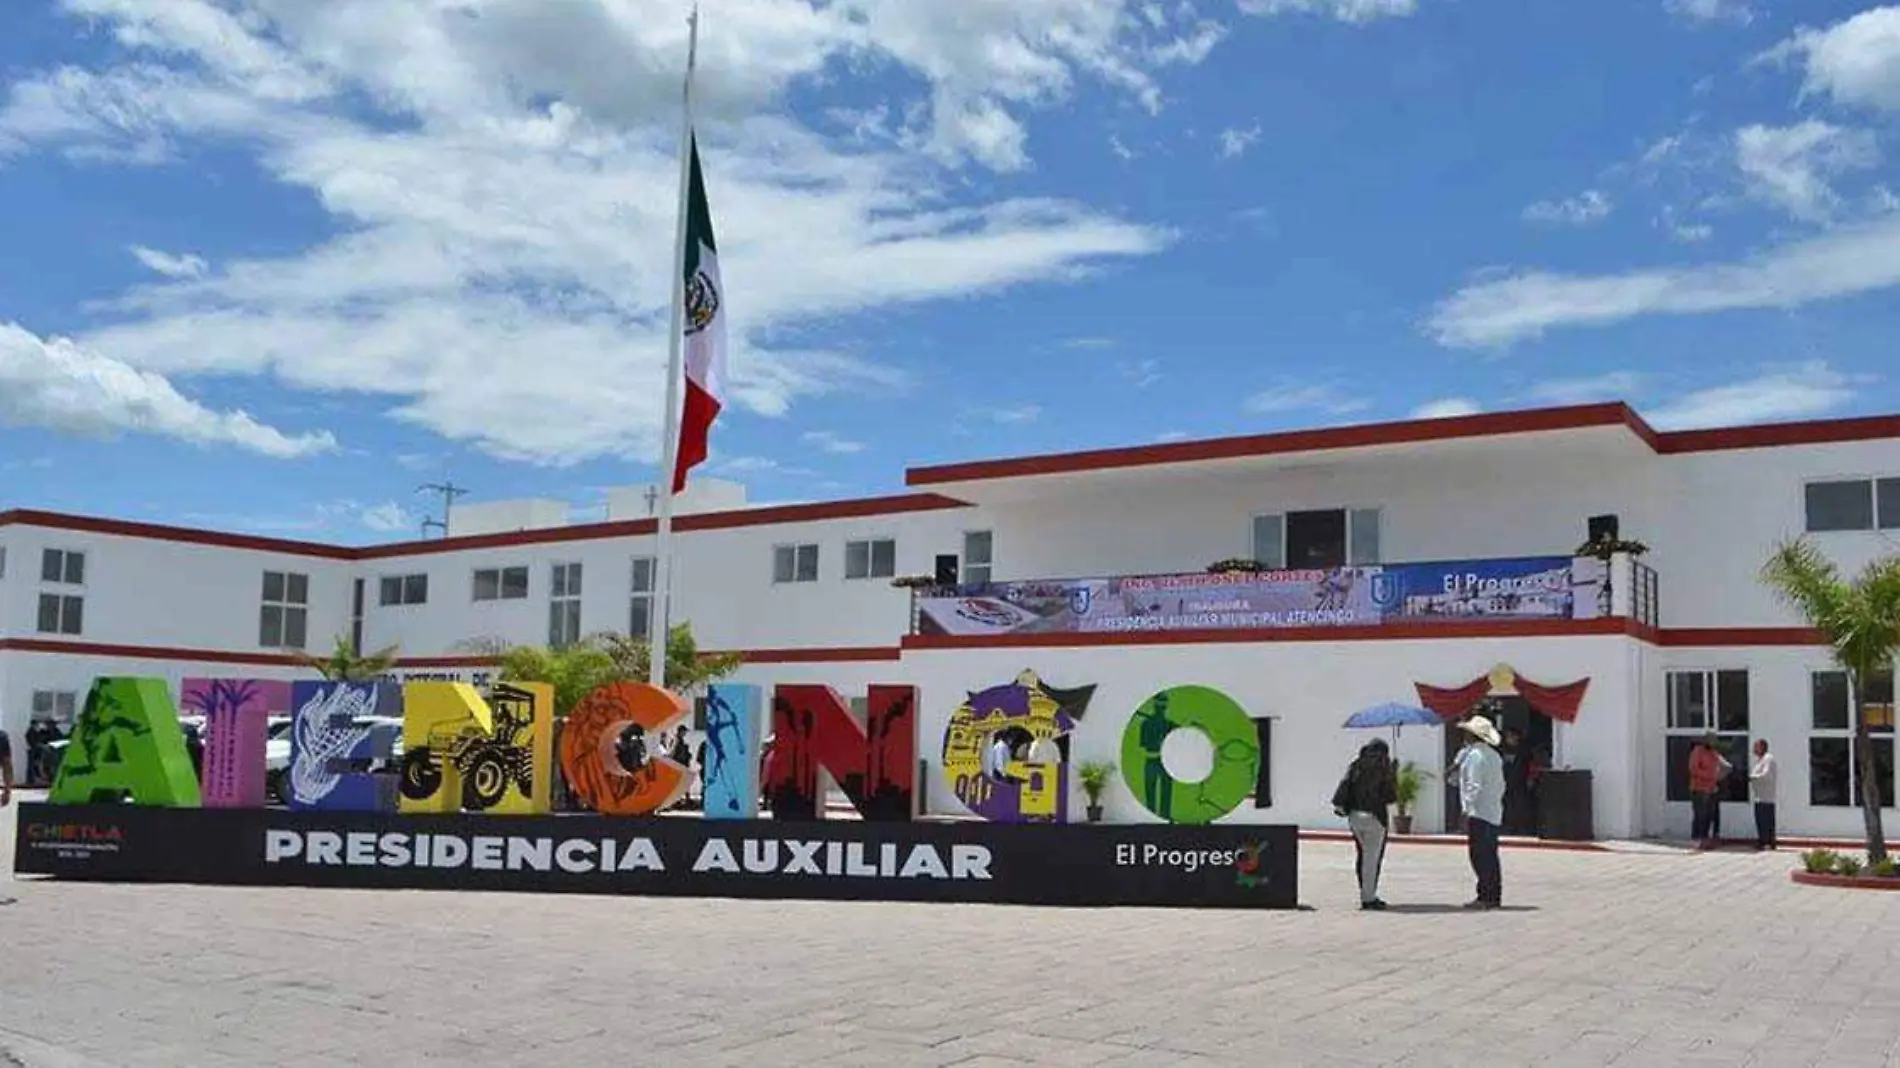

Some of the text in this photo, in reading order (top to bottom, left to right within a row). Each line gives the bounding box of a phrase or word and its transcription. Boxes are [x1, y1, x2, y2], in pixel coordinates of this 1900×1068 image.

[1443, 575, 1460, 592] El
[1286, 608, 1354, 624] ATENCINGO
[47, 676, 1259, 825] ATENCINGO
[28, 823, 124, 839] CHIETLA
[265, 829, 994, 879] PRESIDENCIA AUXILIAR
[1116, 843, 1136, 865] El
